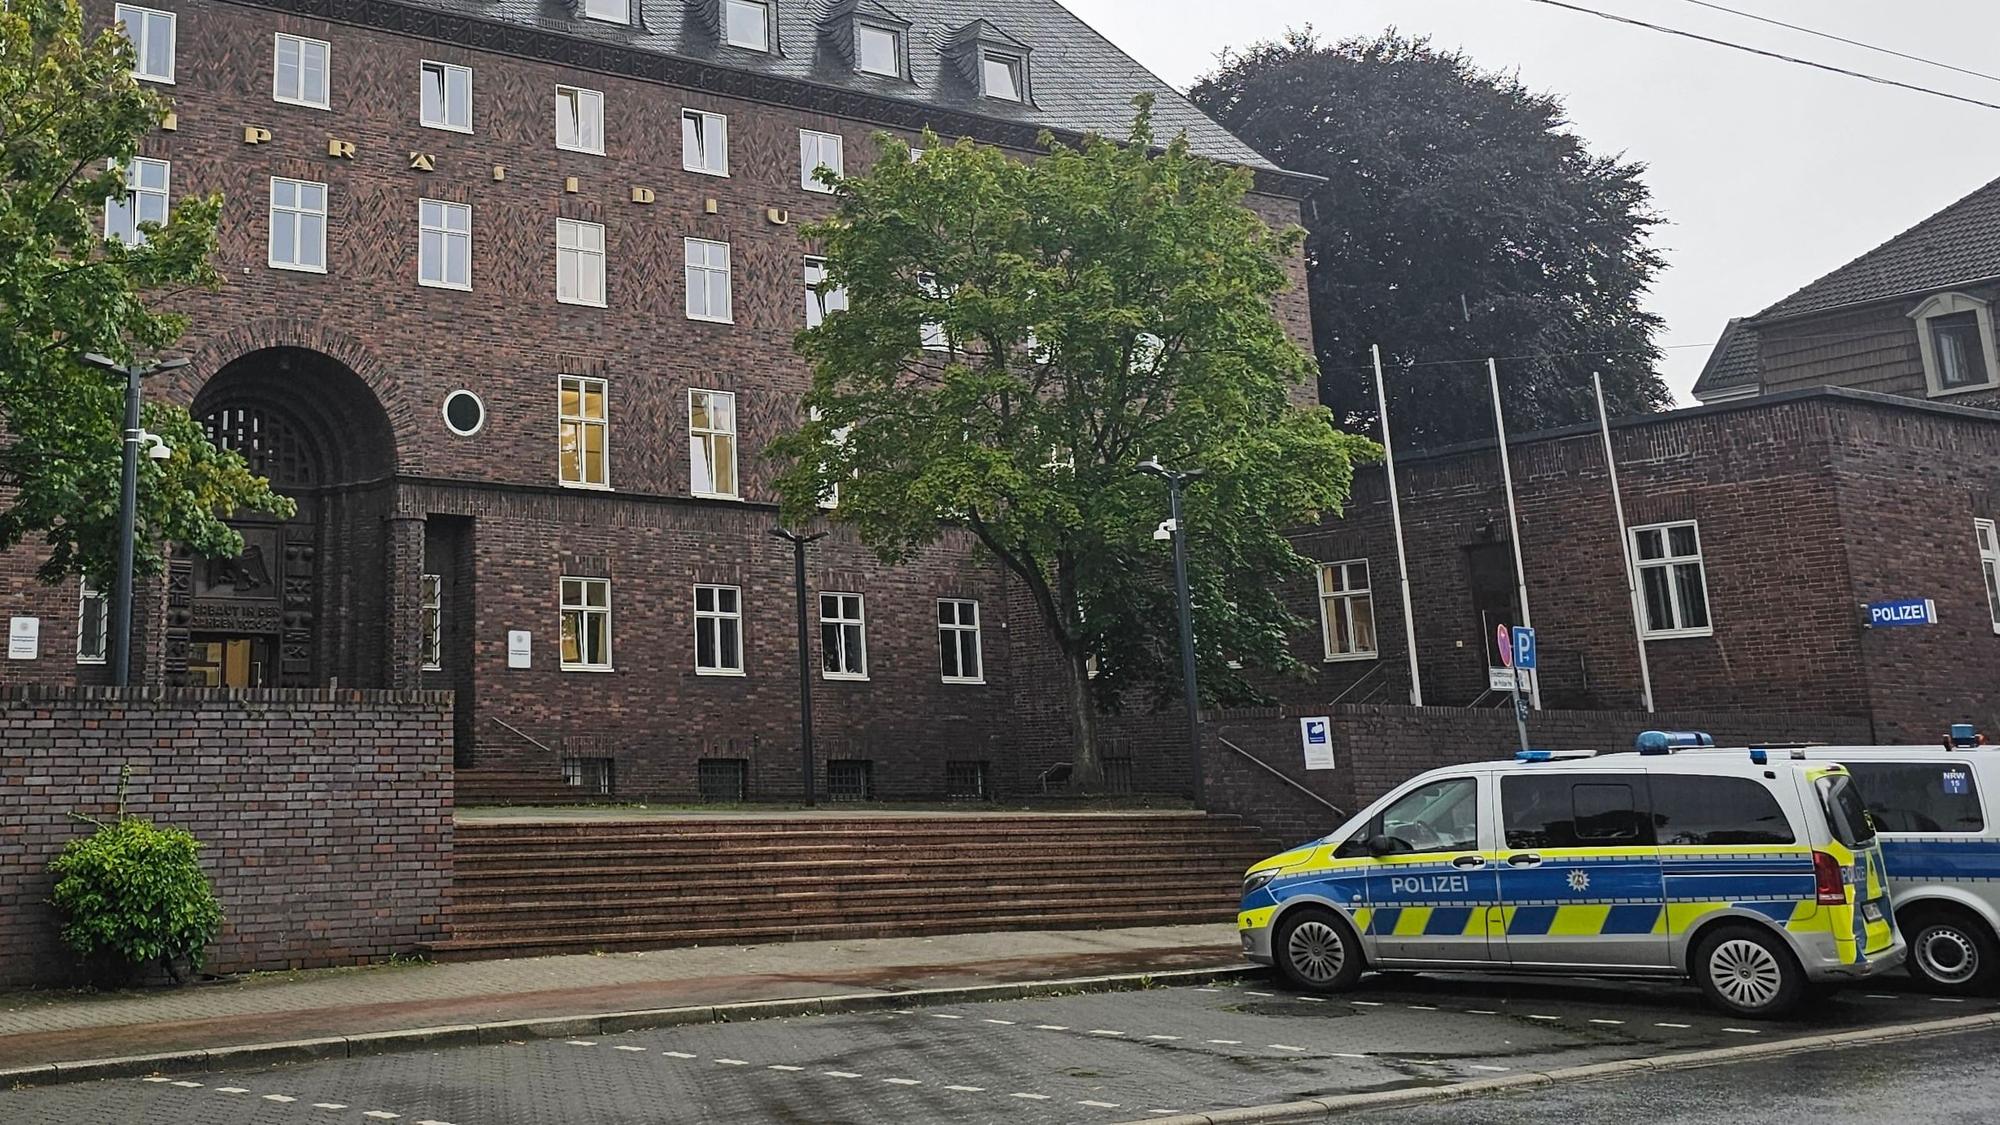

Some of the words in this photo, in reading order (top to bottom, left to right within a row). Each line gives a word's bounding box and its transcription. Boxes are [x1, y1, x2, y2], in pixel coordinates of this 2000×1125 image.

[1872, 604, 1925, 622] POLIZEI
[1518, 633, 1530, 663] P
[1943, 772, 1965, 780] NRW
[1391, 875, 1469, 894] POLIZEI
